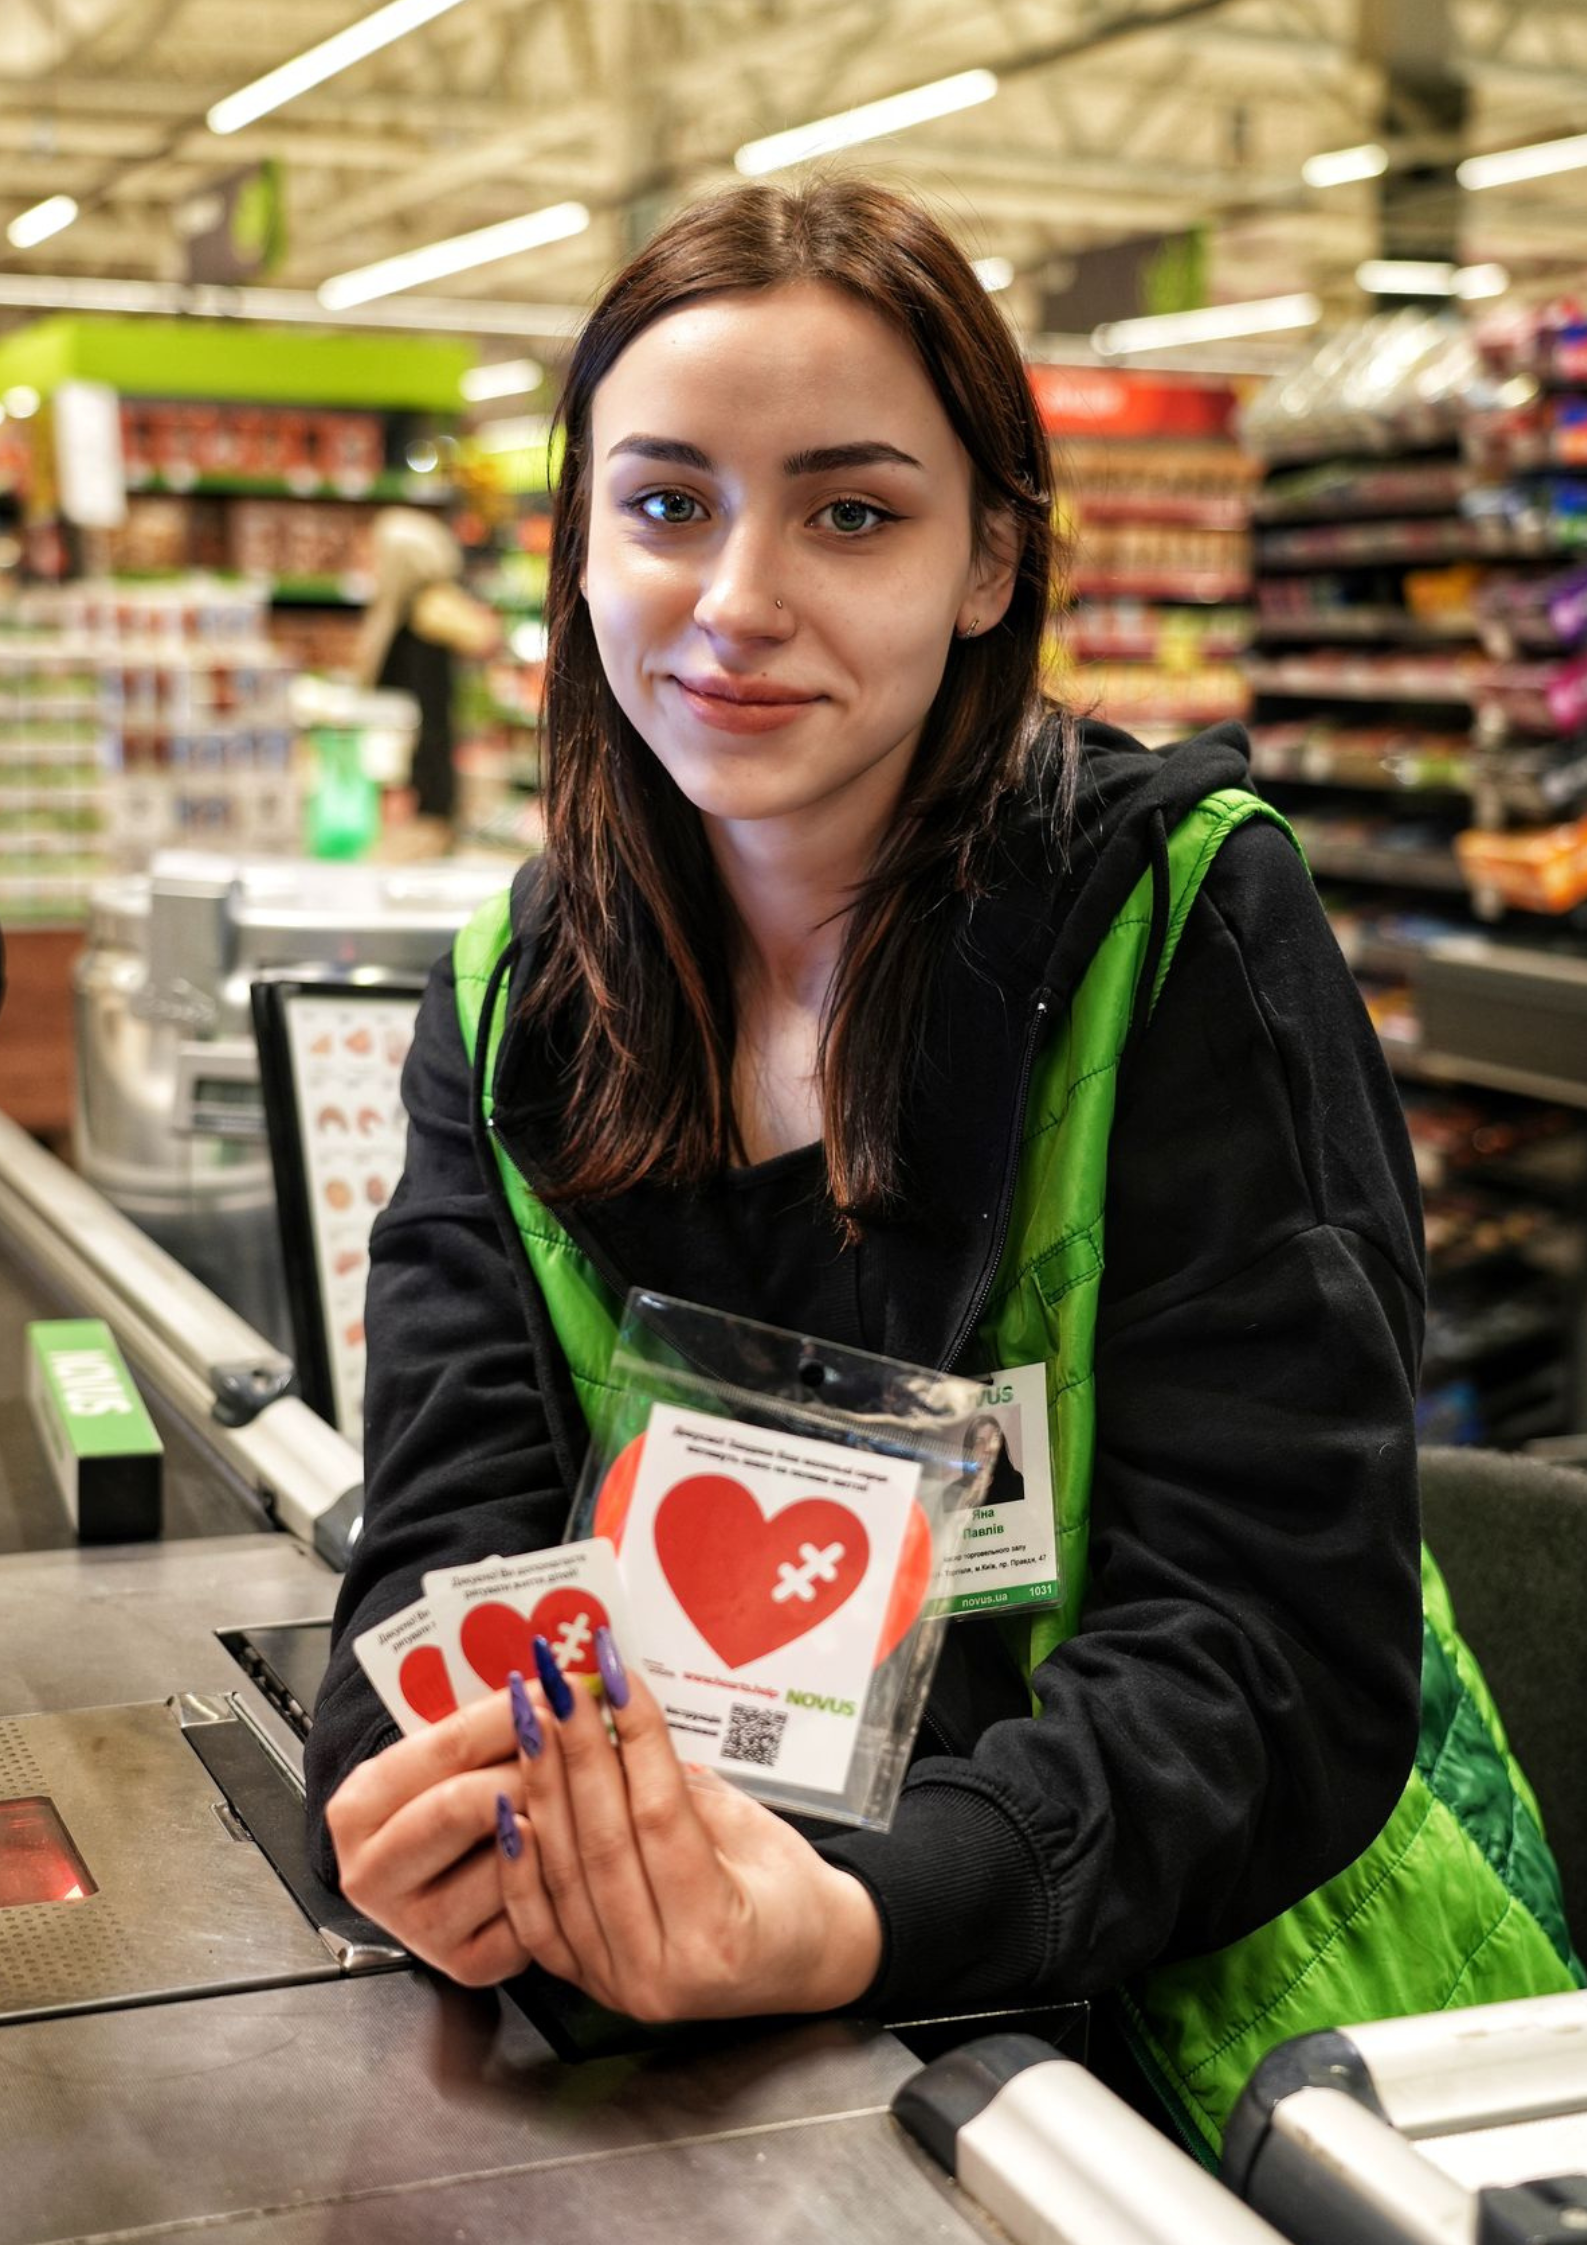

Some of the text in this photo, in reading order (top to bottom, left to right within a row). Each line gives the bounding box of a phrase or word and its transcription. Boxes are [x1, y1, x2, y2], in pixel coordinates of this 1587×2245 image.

[972, 1508, 995, 1521] Яна
[963, 1523, 1005, 1540] Павлів
[962, 1583, 1053, 1608] novus.ua 1031
[785, 1687, 857, 1718] NOVUS
